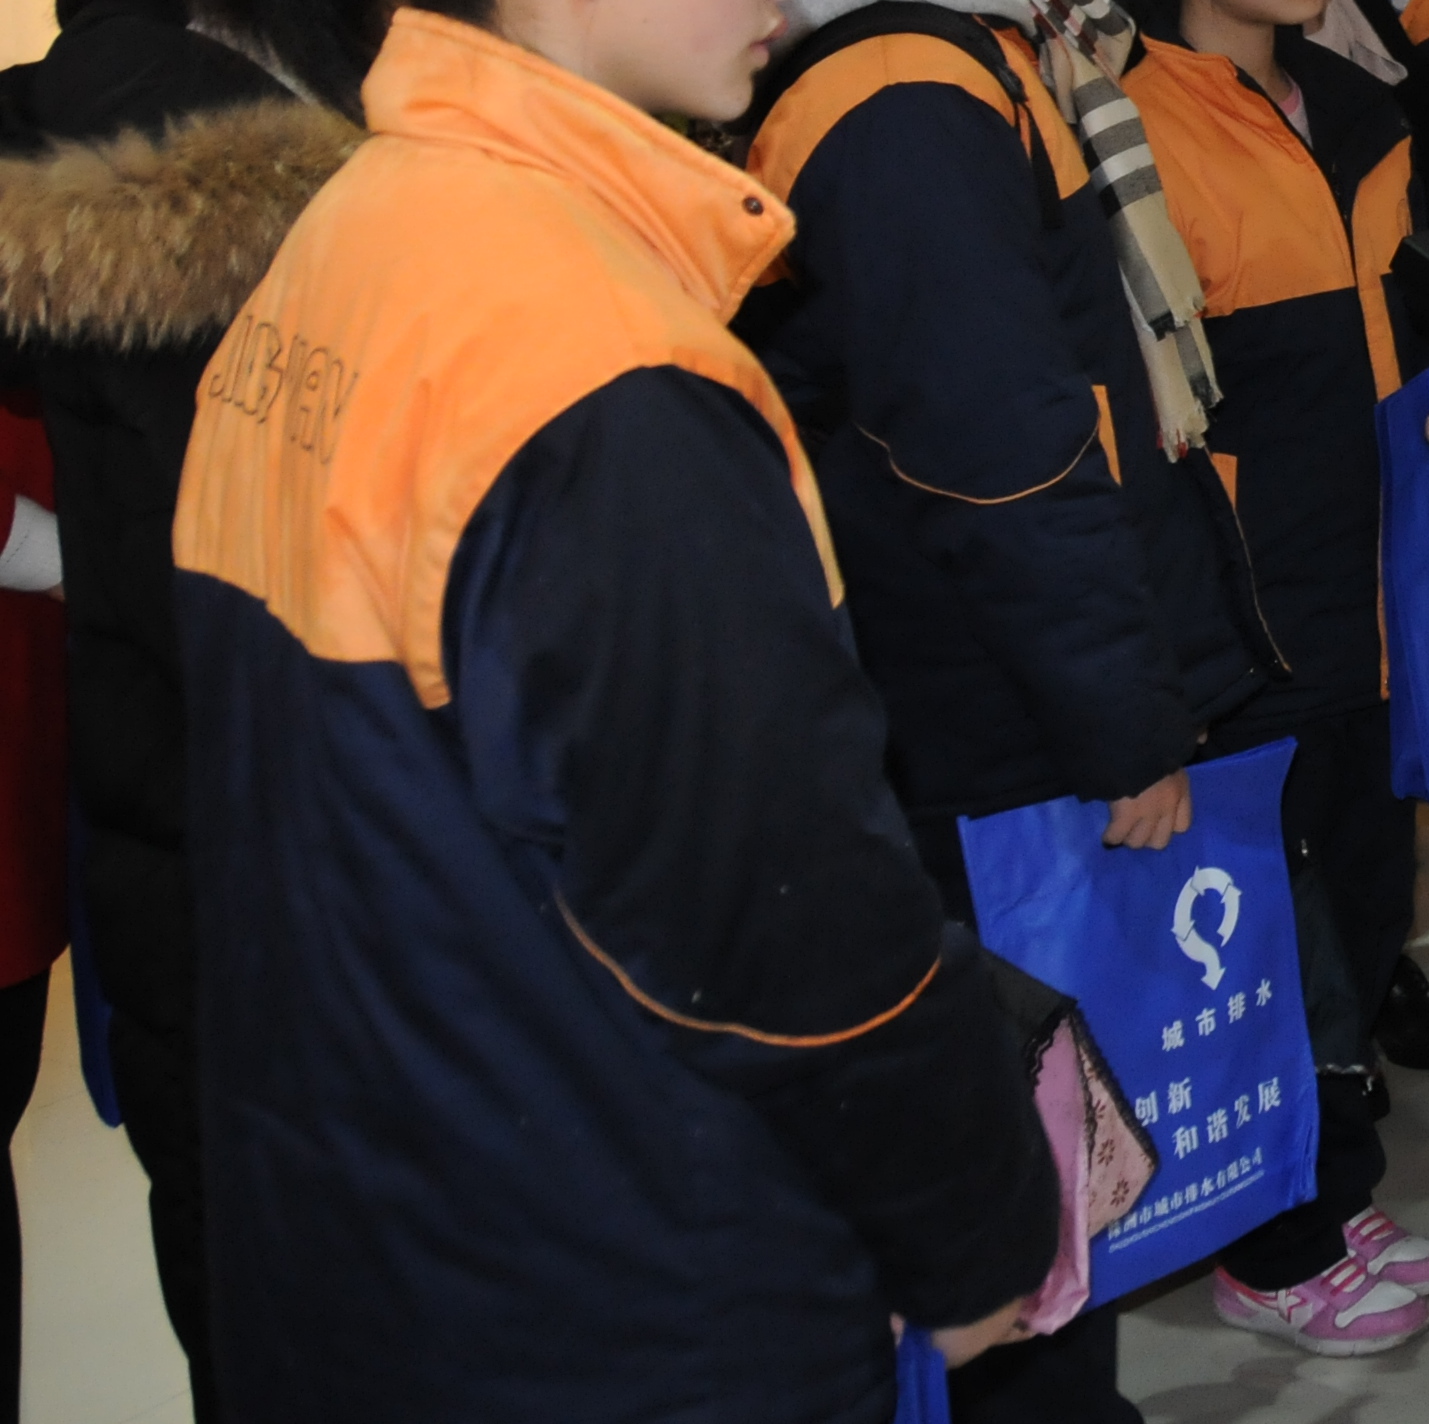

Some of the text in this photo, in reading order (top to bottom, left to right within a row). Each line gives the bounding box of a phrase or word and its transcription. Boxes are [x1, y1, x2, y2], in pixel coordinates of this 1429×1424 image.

[1162, 978, 1273, 1053] 城市排水
[1134, 1077, 1193, 1127] 创新
[1172, 1077, 1282, 1161] 和谐发展
